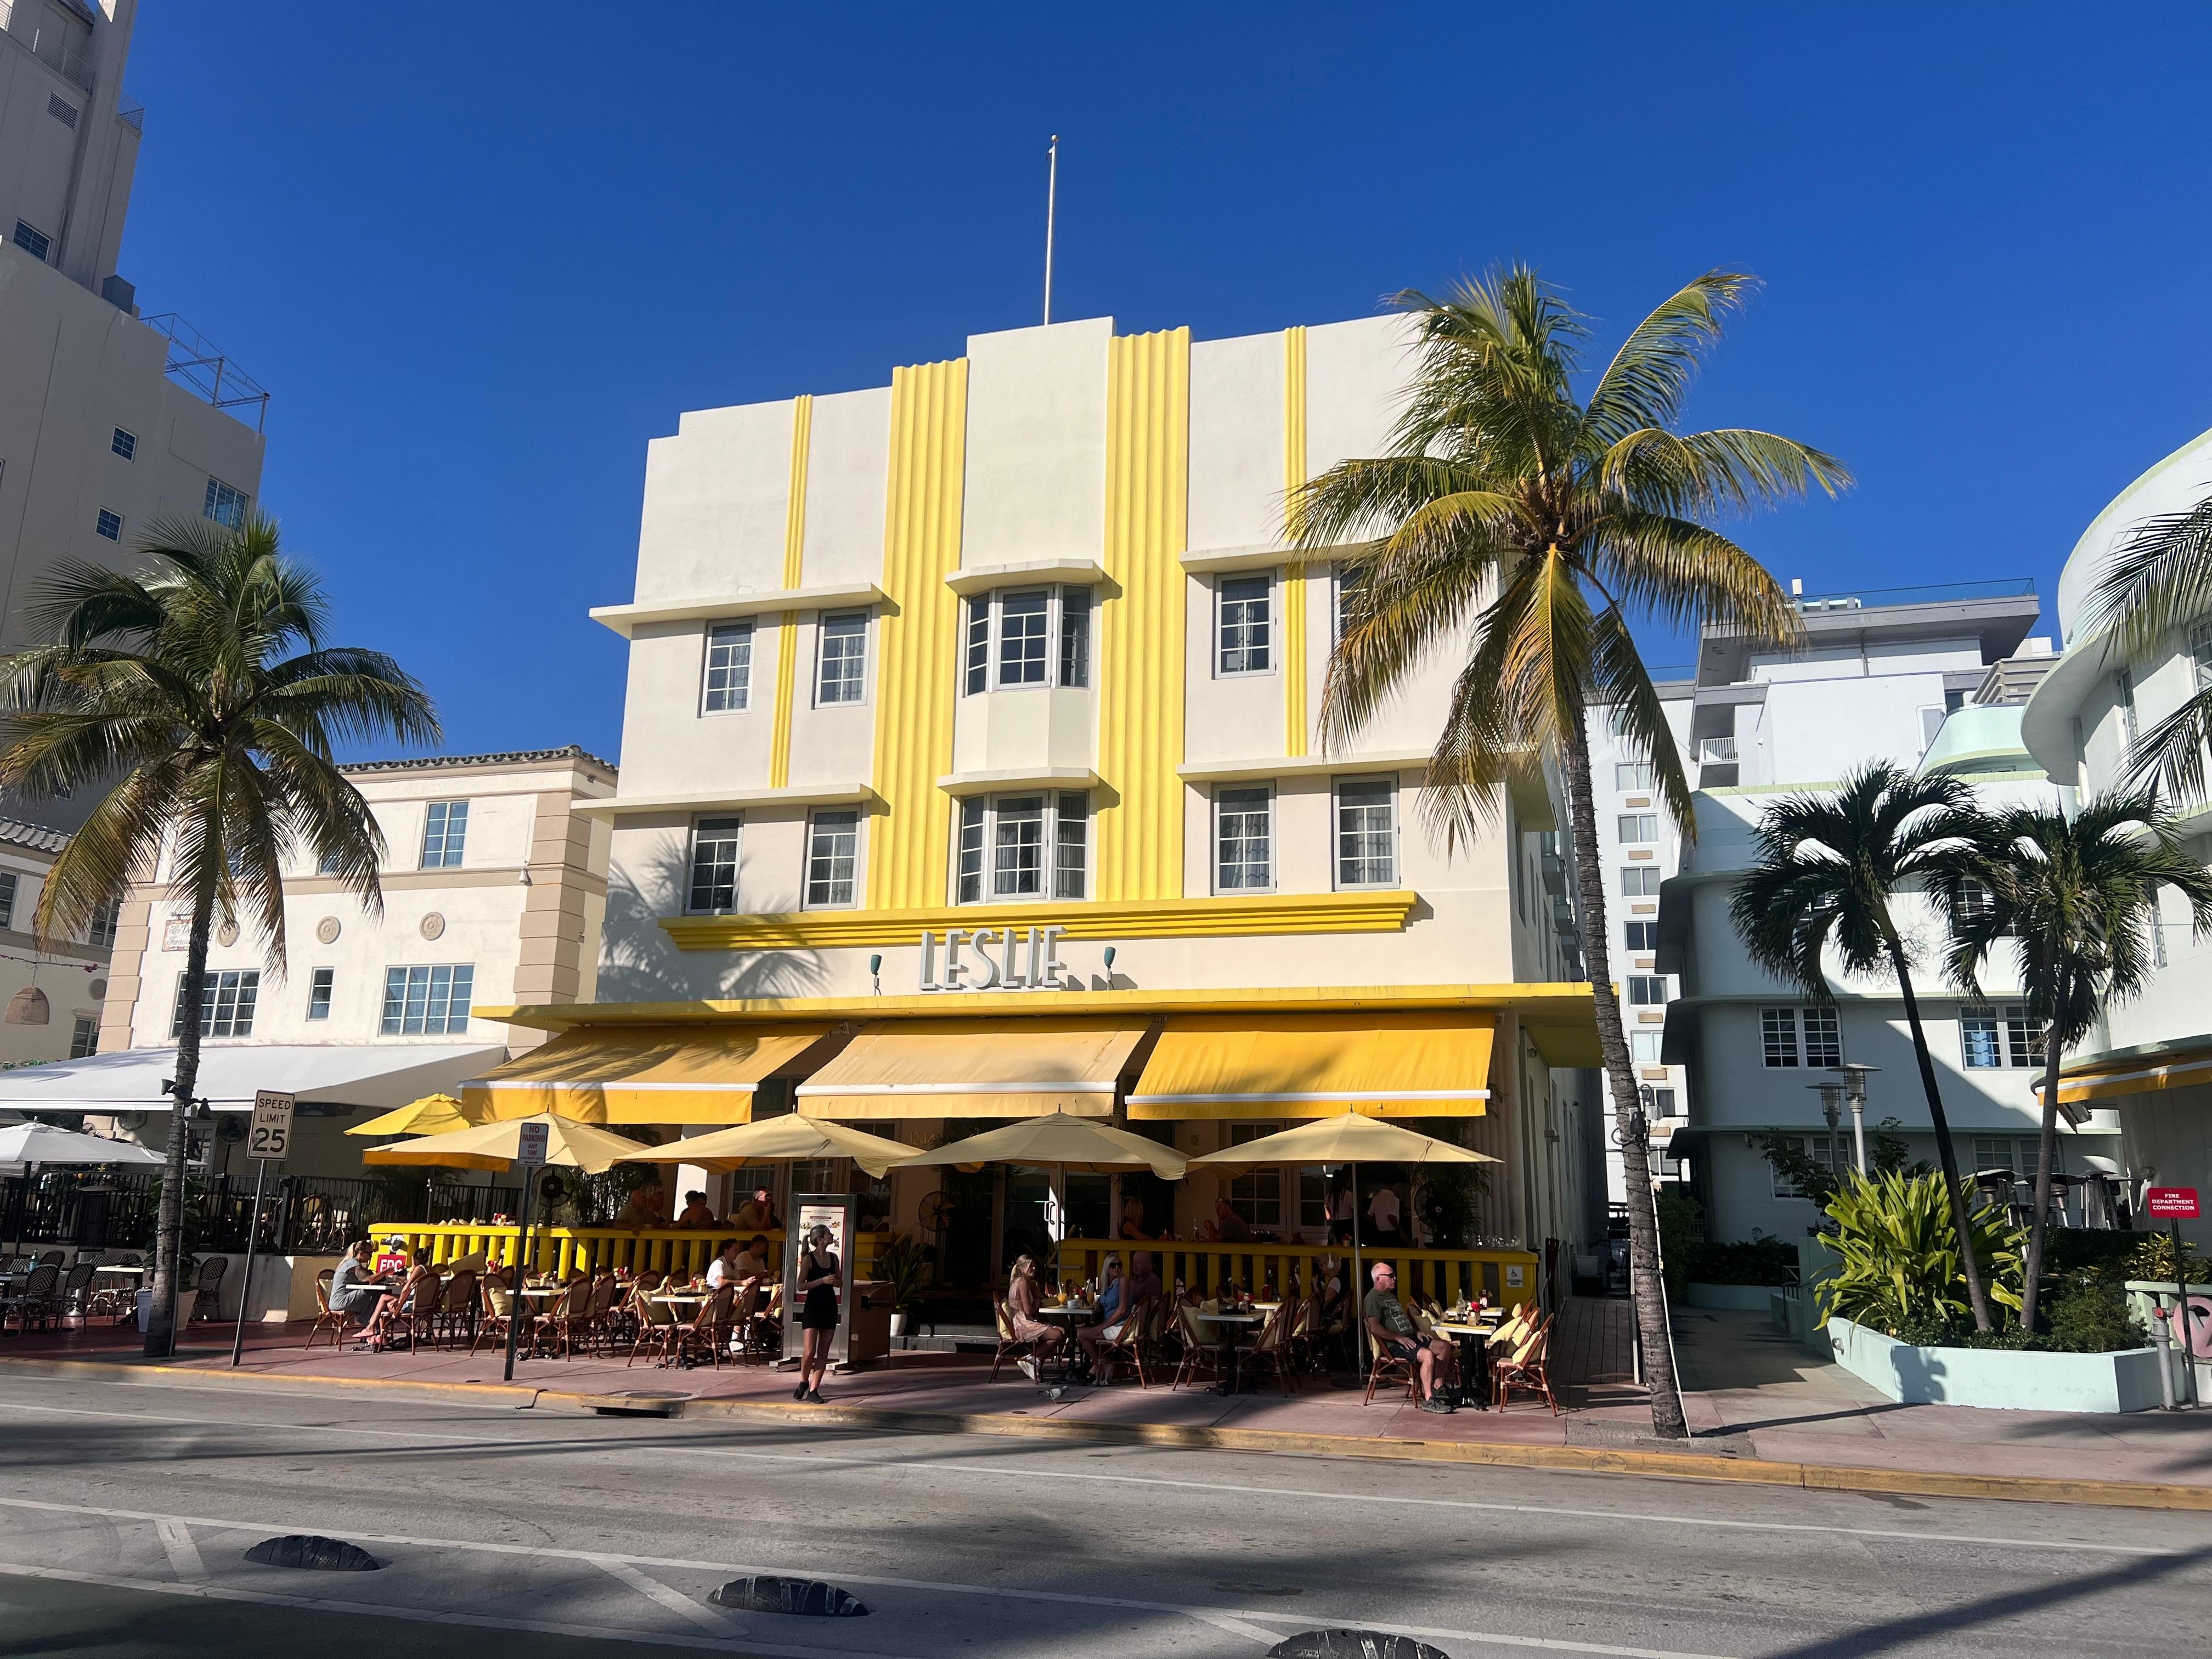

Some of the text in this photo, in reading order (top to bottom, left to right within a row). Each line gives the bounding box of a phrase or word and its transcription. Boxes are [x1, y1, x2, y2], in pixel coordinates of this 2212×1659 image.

[919, 926, 1068, 990] LESLIE
[258, 1098, 291, 1110] SPEED
[259, 1113, 285, 1124] LIMIT
[252, 1127, 285, 1153] 25
[522, 1134, 545, 1142] PARKING
[380, 1259, 403, 1272] FDC
